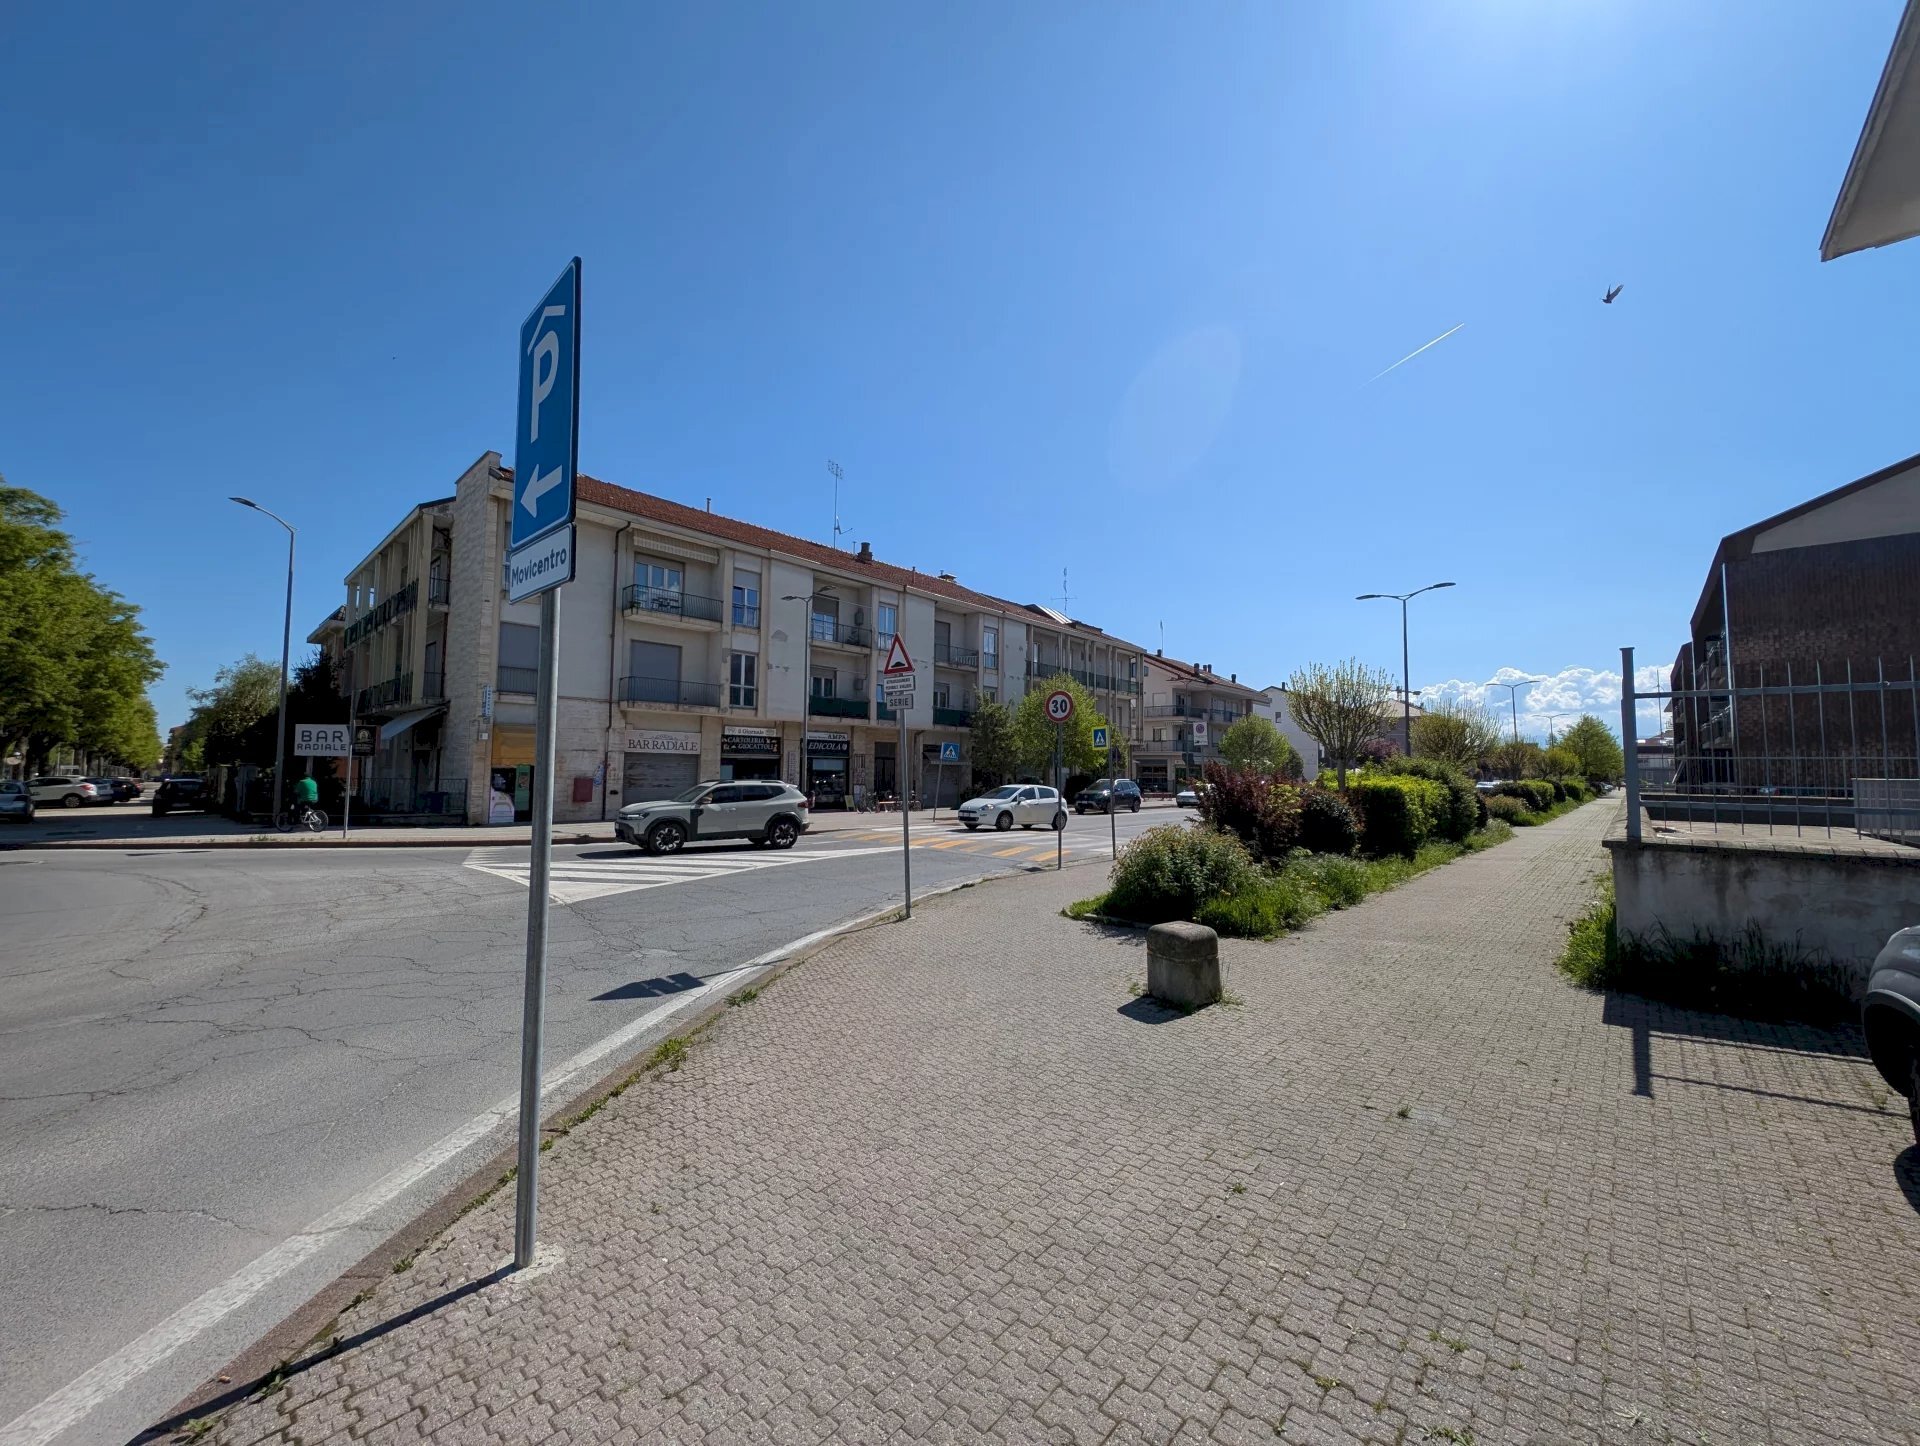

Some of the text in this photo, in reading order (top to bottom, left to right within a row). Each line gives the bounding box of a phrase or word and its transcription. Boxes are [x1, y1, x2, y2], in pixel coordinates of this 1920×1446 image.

[531, 330, 560, 443] P
[511, 548, 567, 588] Movicentro
[890, 697, 909, 706] SERIE
[1051, 699, 1068, 713] 30
[301, 730, 343, 742] BAR
[728, 736, 764, 744] CARTOLERIA
[297, 743, 347, 751] RADIALE
[628, 739, 698, 751] BAR RADIALE
[808, 742, 841, 750] EDICOLA
